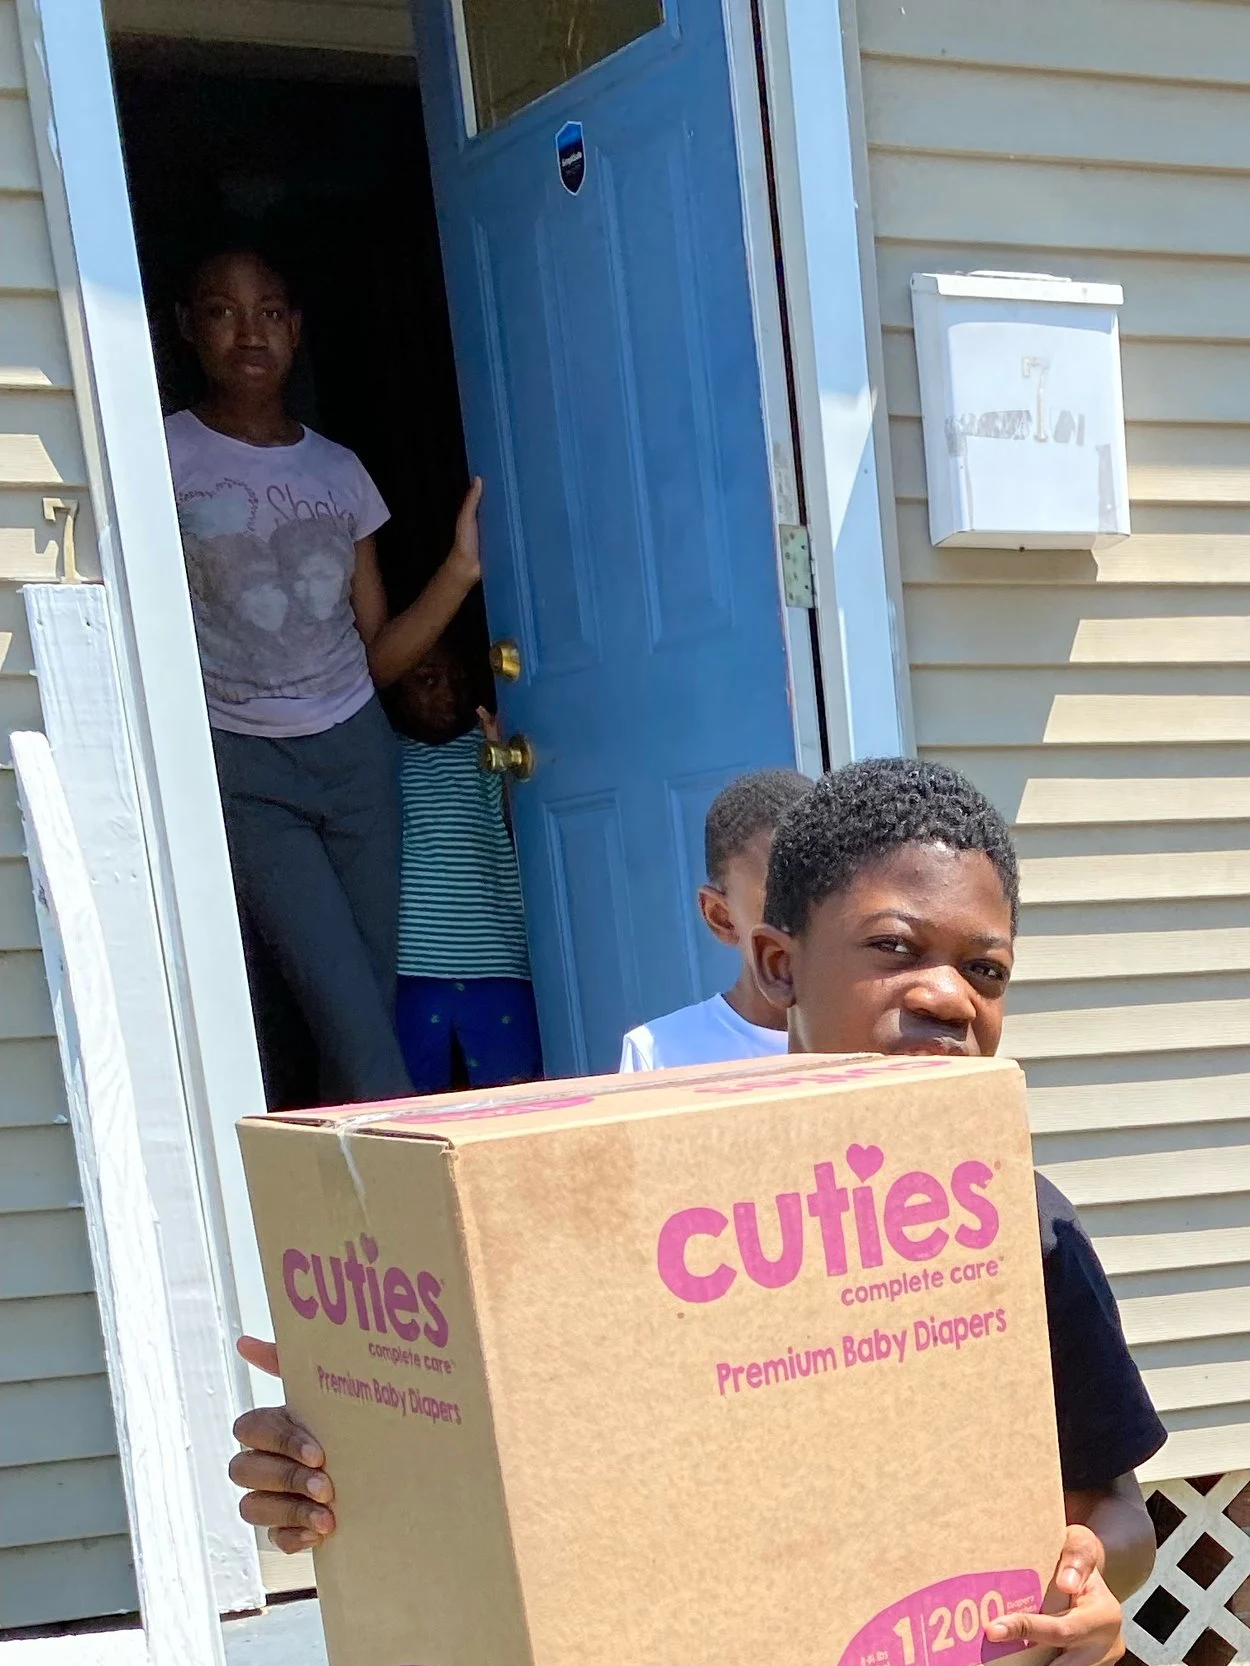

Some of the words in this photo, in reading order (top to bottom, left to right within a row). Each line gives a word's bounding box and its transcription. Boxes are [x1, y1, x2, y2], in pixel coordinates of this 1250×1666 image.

[657, 1142, 1000, 1303] cuties
[282, 1232, 449, 1348] cuties
[841, 1268, 944, 1306] complete
[950, 1260, 999, 1286] care
[368, 1343, 421, 1369] complete
[424, 1355, 452, 1374] care
[716, 1346, 837, 1396] Premium
[842, 1328, 908, 1368] Baby
[913, 1308, 1007, 1351] Diapers
[317, 1365, 373, 1400] Premium
[373, 1378, 406, 1416] Baby
[408, 1388, 462, 1425] Diapers
[893, 1616, 915, 1666] 1
[929, 1590, 1005, 1652] 200
